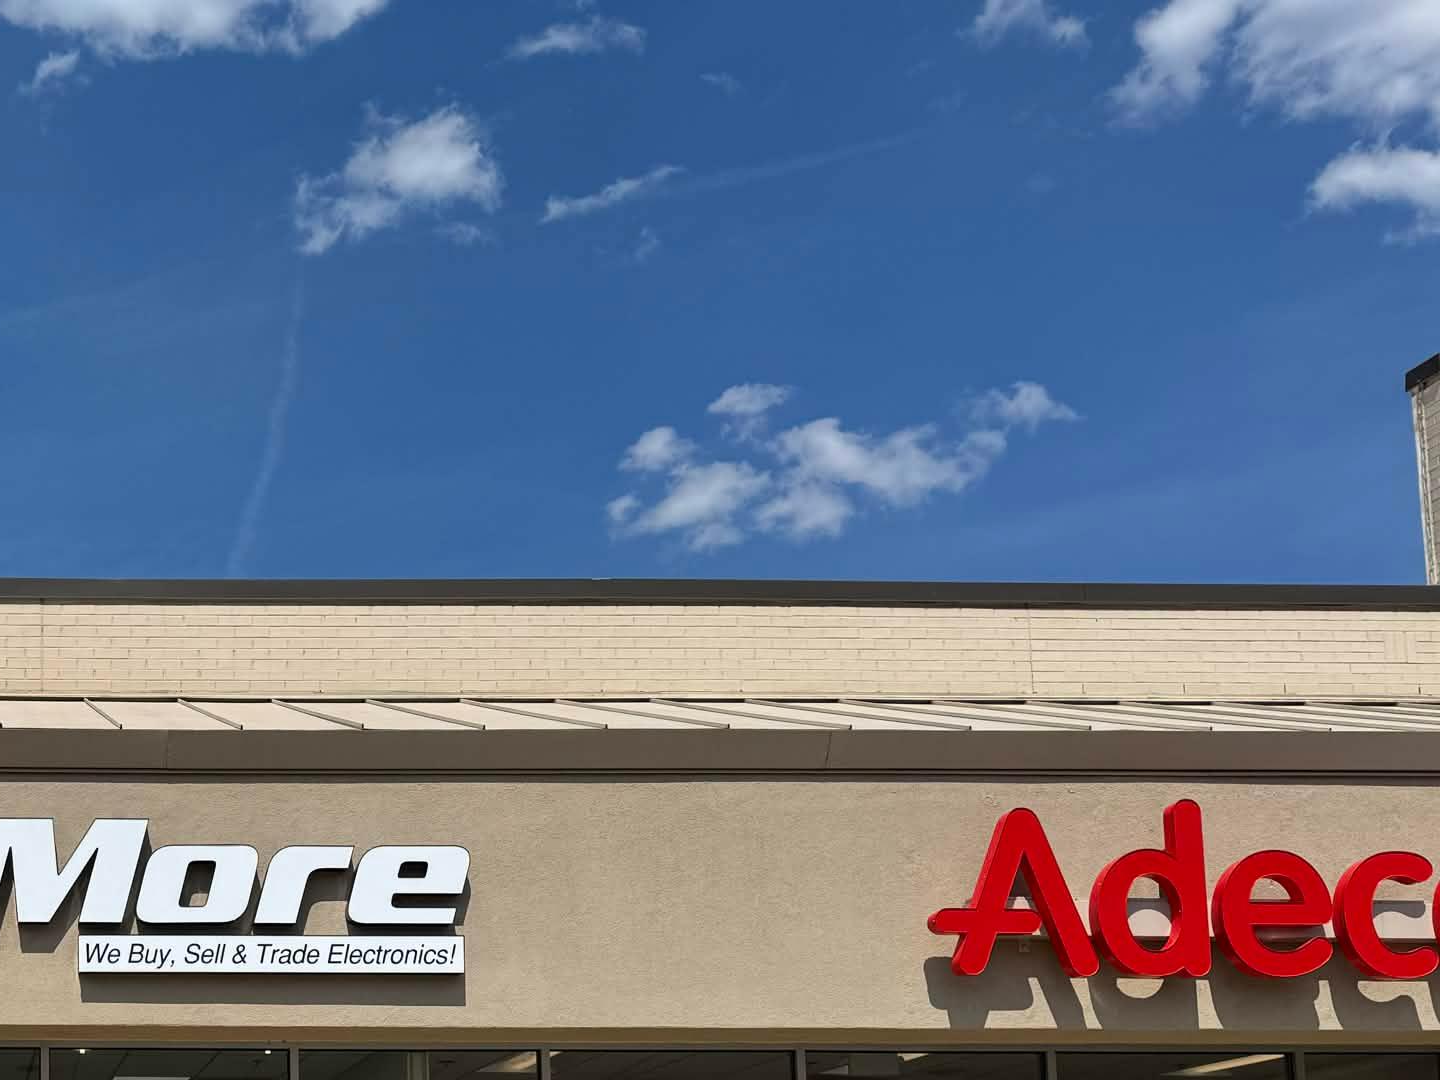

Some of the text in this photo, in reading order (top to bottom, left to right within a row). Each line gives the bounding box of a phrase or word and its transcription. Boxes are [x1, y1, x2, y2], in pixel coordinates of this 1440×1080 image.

[927, 798, 1440, 979] Adec
[85, 943, 457, 969] We Buy, Sell & Trade Electronics!
